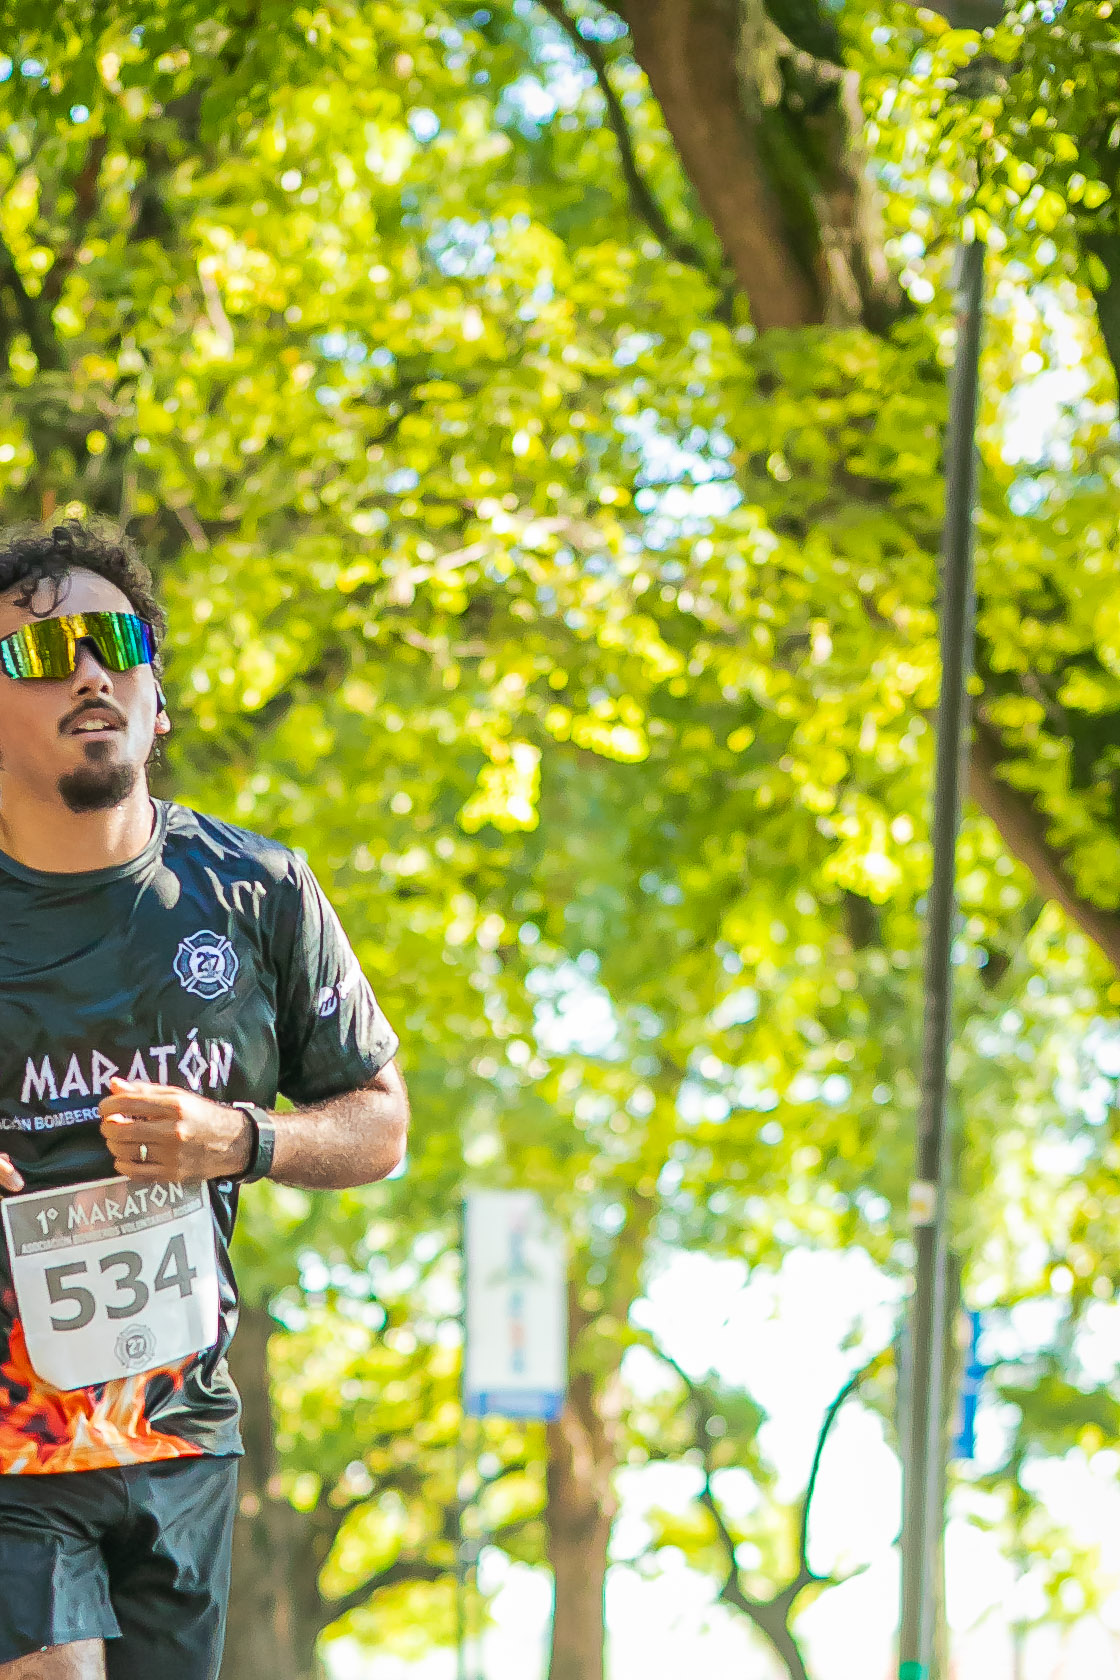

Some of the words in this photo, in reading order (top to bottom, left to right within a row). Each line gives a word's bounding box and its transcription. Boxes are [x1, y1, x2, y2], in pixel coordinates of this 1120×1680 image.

[196, 951, 220, 973] 27
[21, 1027, 234, 1104] MARATÓN
[34, 1106, 100, 1131] BOMBERO
[44, 1233, 198, 1332] 534
